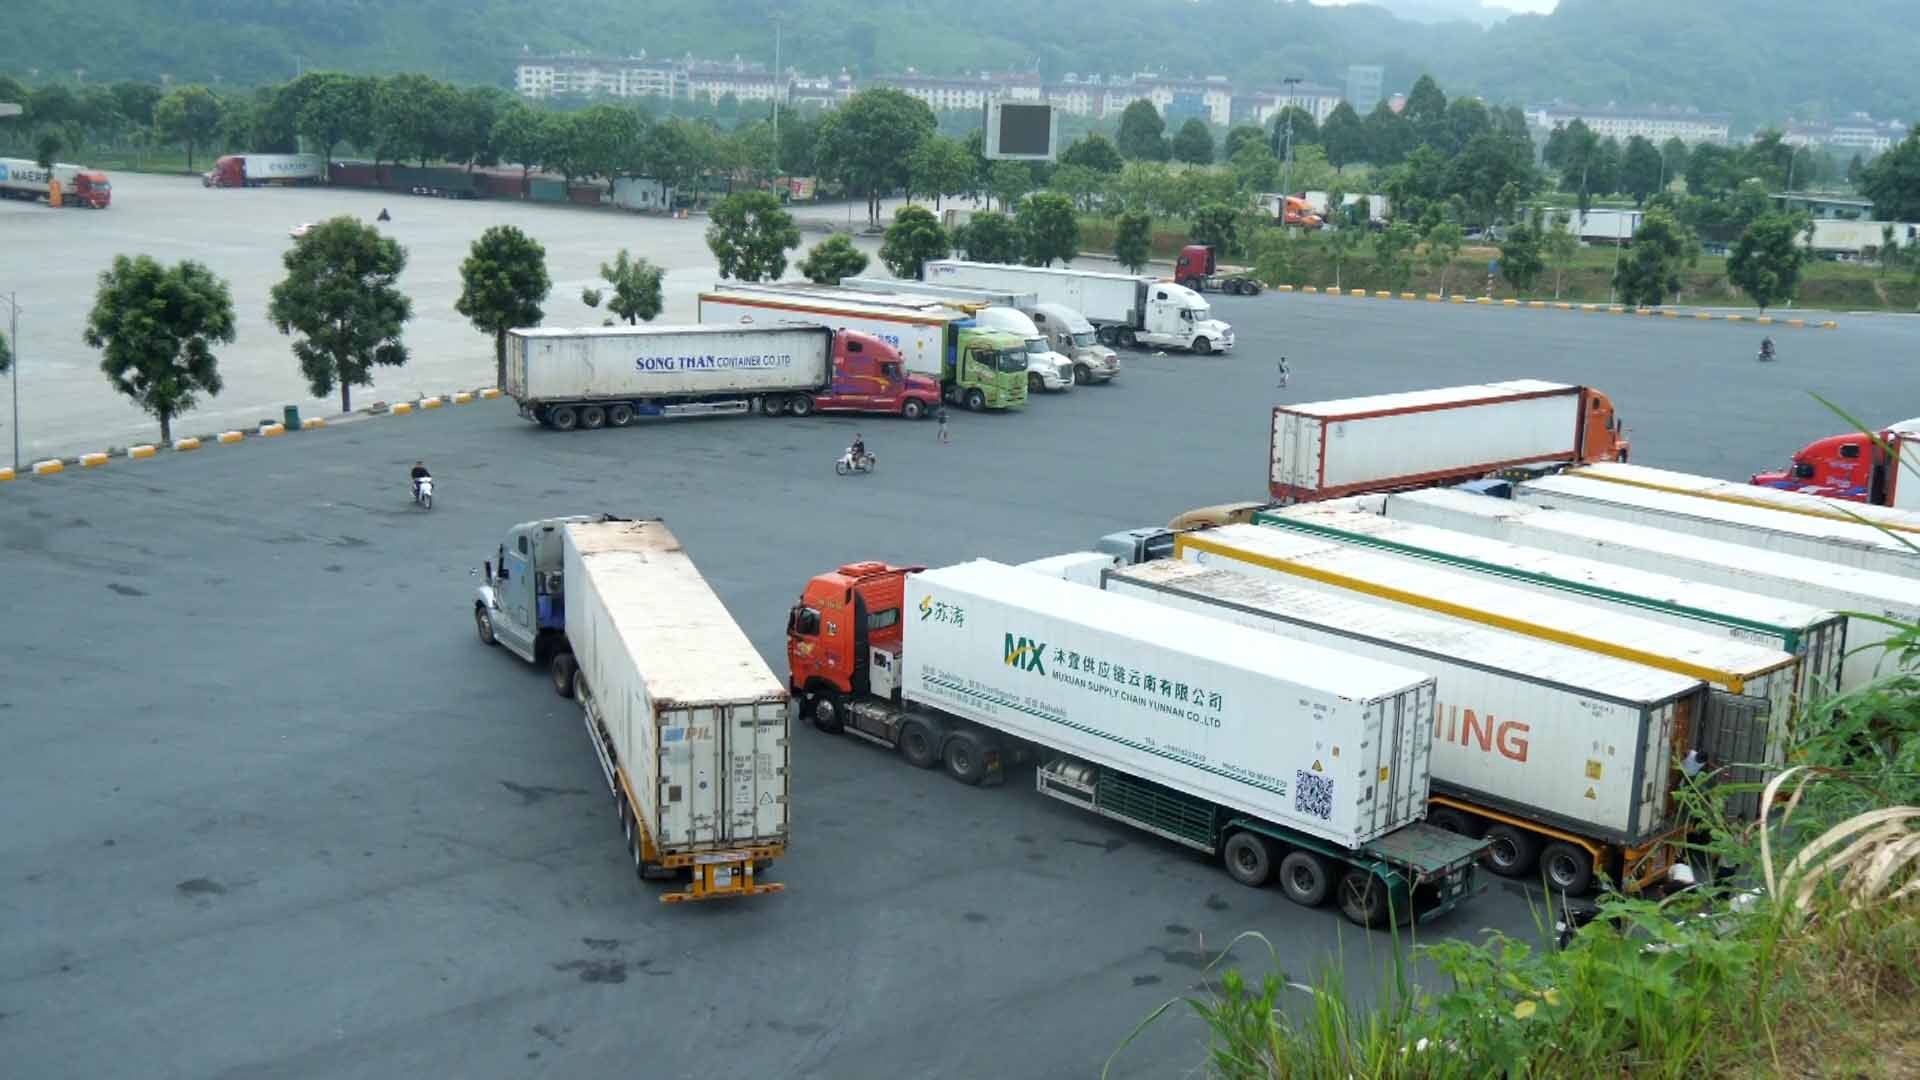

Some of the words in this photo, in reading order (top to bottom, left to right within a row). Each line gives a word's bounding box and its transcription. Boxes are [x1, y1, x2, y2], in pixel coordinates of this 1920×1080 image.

[636, 357, 674, 370] SONG
[679, 355, 715, 368] THAN
[717, 355, 761, 367] CONTAINER
[1004, 632, 1047, 676] MX
[1052, 669, 1086, 688] MUXUAN
[1087, 682, 1119, 698] SUPPLY
[1120, 691, 1147, 706] CHAIN
[1149, 701, 1185, 718] YUNNAN
[685, 727, 713, 741] PIL
